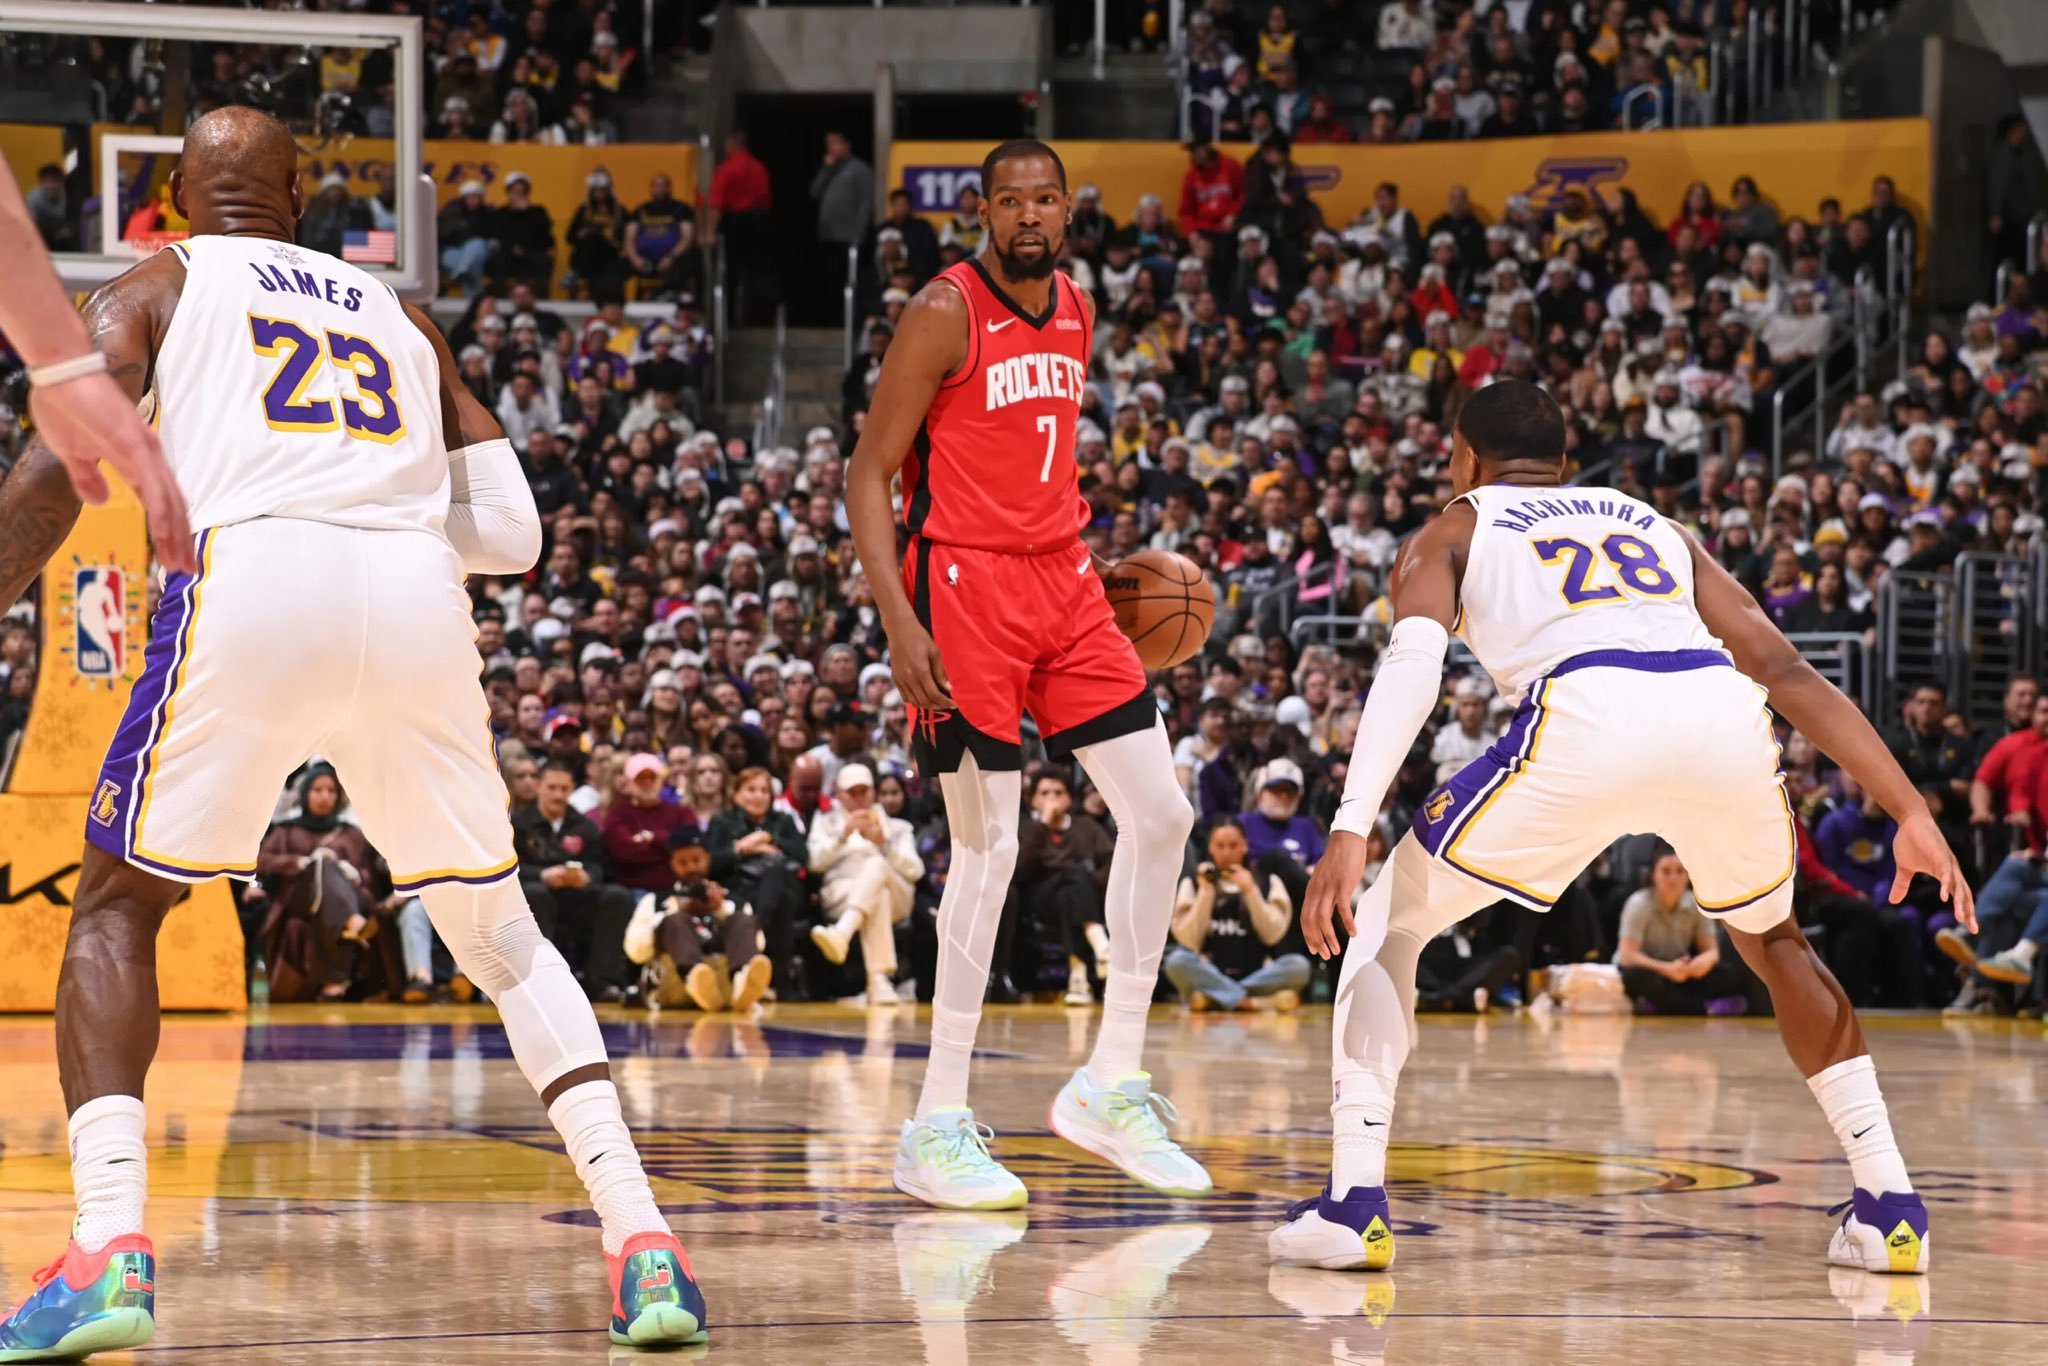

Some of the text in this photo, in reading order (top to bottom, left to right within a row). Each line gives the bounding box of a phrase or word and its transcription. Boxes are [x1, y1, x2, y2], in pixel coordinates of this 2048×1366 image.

[303, 160, 501, 184] ANGES
[249, 262, 363, 312] JAMES
[247, 312, 407, 445] 23
[986, 352, 1084, 412] ROCKETS
[1036, 415, 1057, 483] 7
[1492, 499, 1656, 533] HACHIMURA
[1528, 532, 1684, 611] 28
[82, 651, 107, 670] NBA
